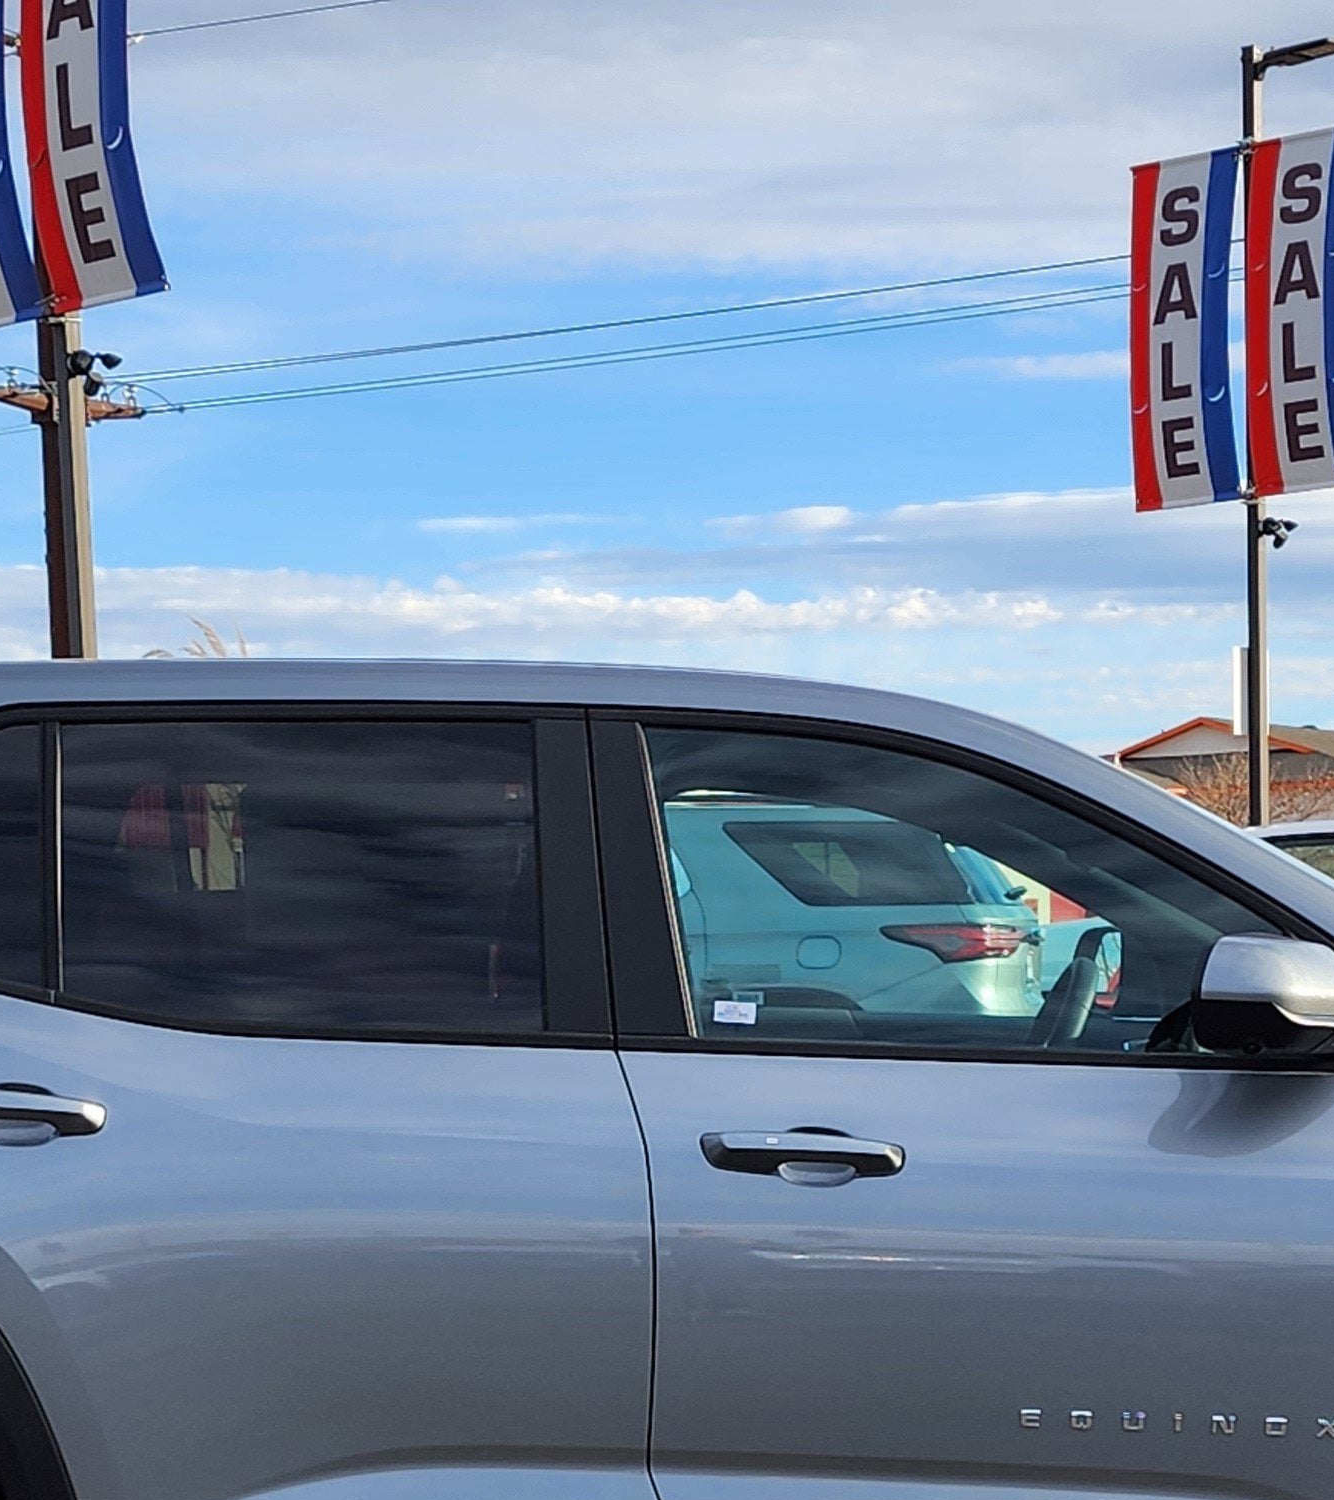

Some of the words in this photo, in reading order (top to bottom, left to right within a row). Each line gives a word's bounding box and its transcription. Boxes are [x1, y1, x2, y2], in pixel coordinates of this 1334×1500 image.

[46, 0, 116, 264] ALE
[1152, 185, 1201, 479] SALE
[1273, 162, 1325, 463] SALE
